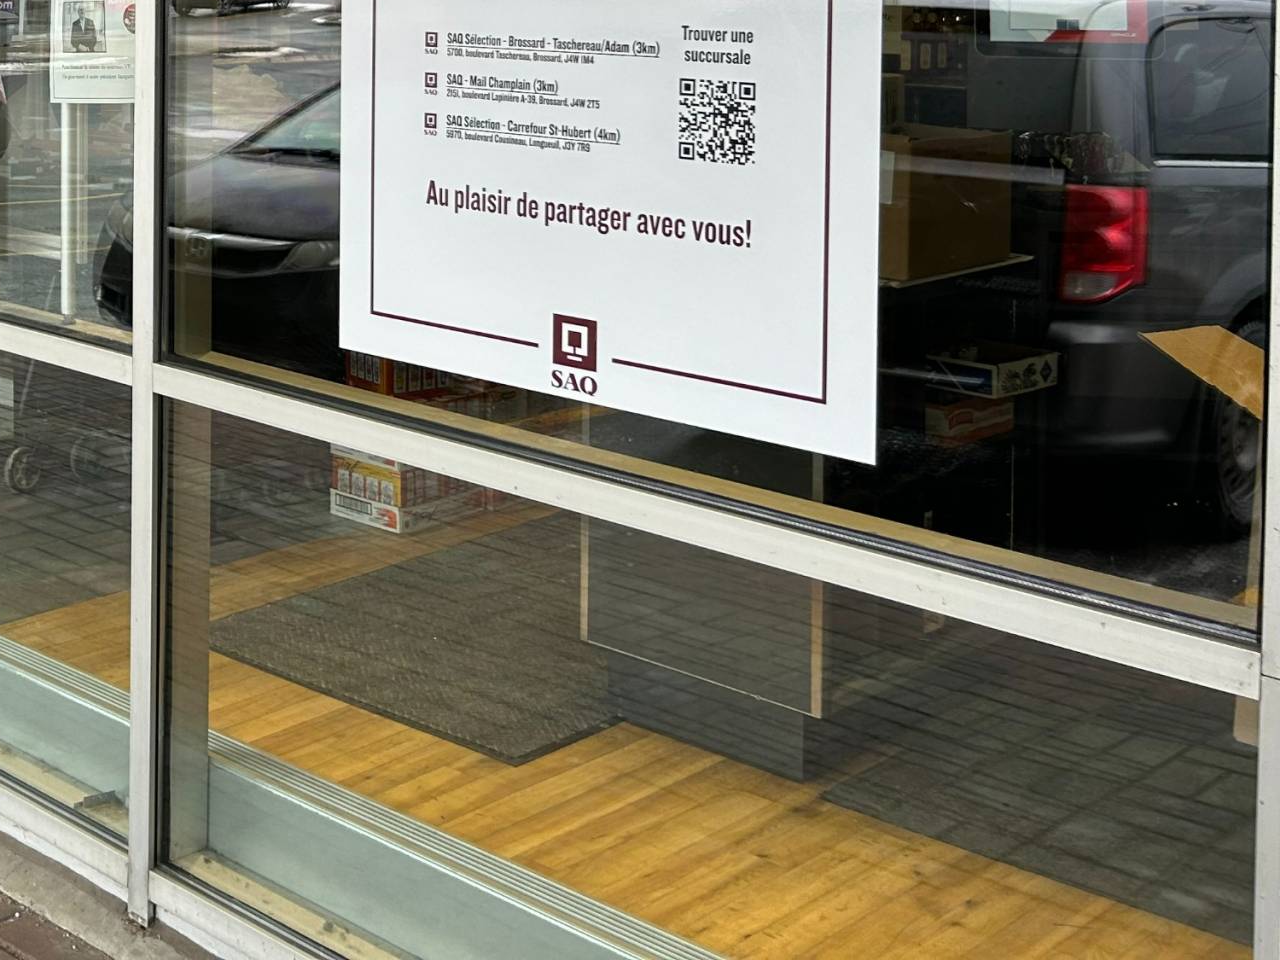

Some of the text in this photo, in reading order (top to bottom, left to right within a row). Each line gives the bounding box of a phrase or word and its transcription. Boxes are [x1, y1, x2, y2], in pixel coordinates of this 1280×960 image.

[446, 32, 464, 44] SAQ
[464, 33, 501, 46] Sélection
[508, 35, 545, 49] Brossard
[551, 37, 630, 53] Taschereau/Adam
[631, 40, 660, 56] (3km)
[681, 25, 754, 44] Trouver une
[683, 48, 751, 65] succursale
[446, 73, 463, 86] SAQ
[469, 74, 487, 87] Mail
[488, 76, 531, 91] Champlain
[532, 78, 559, 94] (3km)
[445, 114, 463, 127] SAQ
[463, 115, 500, 130] Sélection
[507, 119, 547, 135] Carrefour
[548, 123, 592, 139] St-Hubert
[593, 126, 621, 143] (4km)
[426, 179, 751, 248] Au plaisir de partager avec vous!
[551, 369, 598, 397] SAQ
